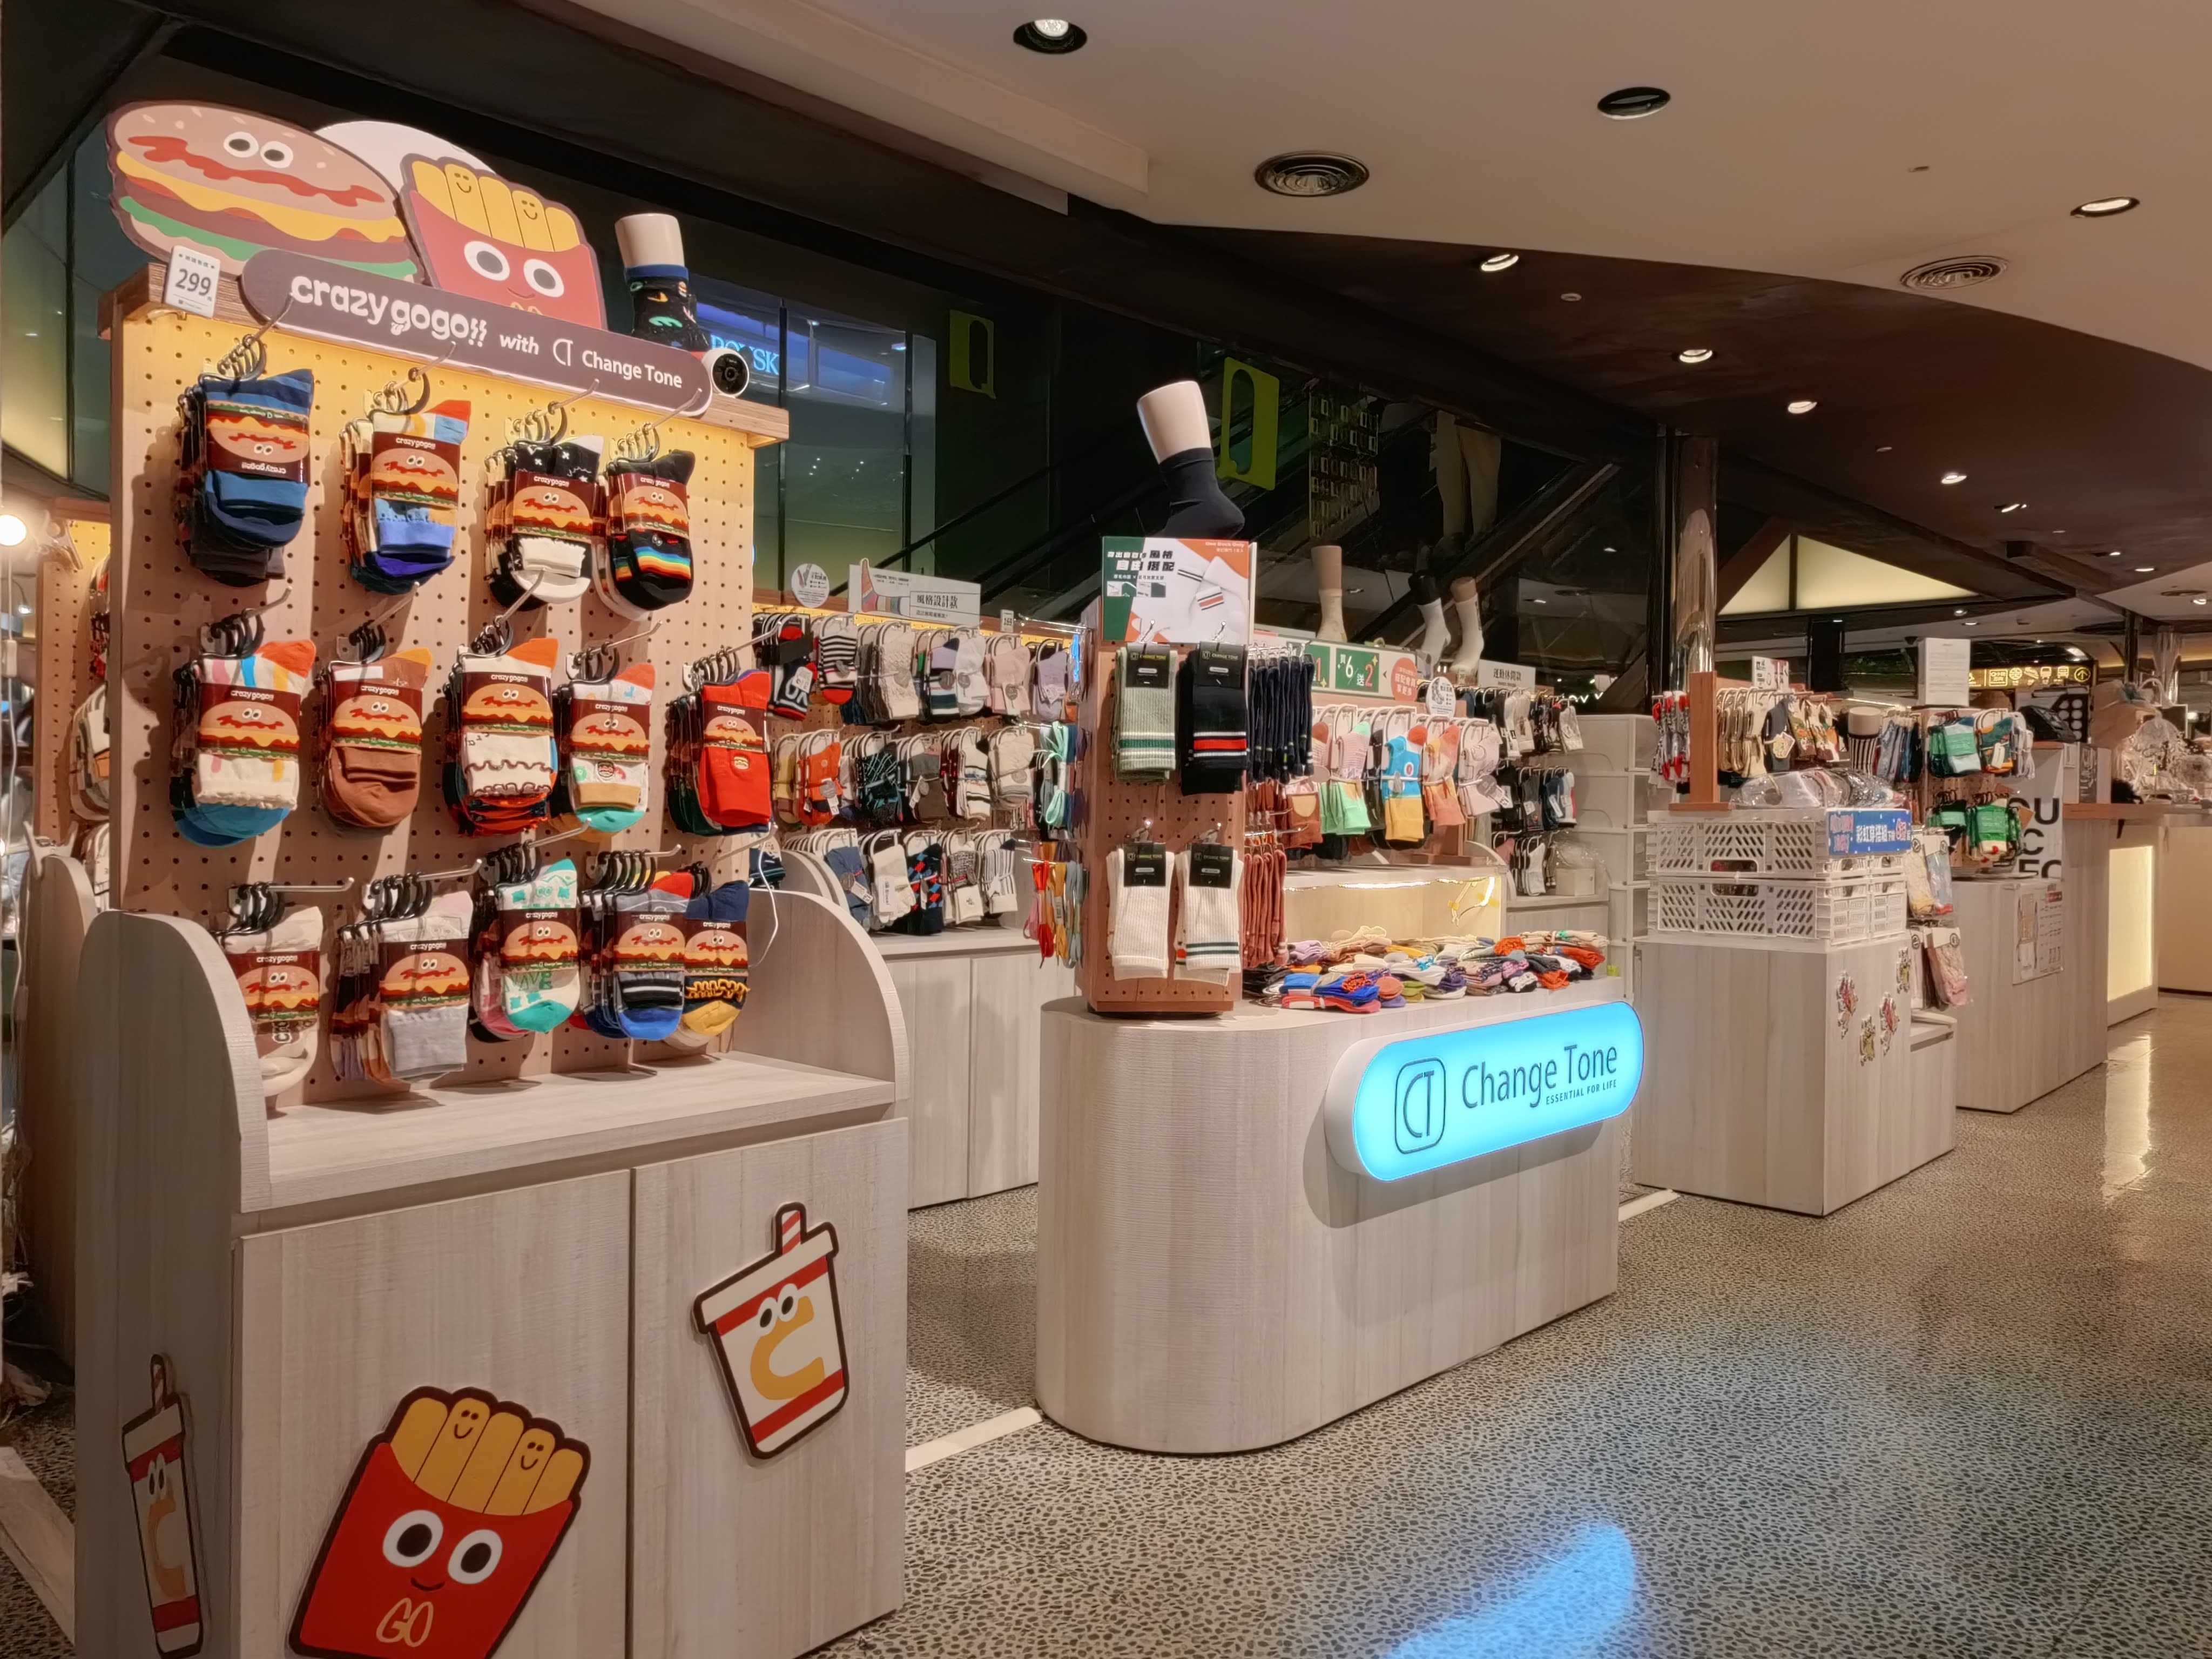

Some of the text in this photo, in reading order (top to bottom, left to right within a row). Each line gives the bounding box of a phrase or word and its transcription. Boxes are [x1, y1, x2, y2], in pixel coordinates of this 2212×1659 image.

[176, 268, 211, 296] 299
[500, 334, 539, 355] with
[582, 350, 642, 380] Change
[645, 364, 683, 389] Tone
[917, 595, 957, 609] 風格設計款
[1461, 1059, 1557, 1109] Change
[1564, 1044, 1617, 1084] Tone
[1546, 1080, 1617, 1105] ESSENTIAL FOR LIFE
[376, 1597, 434, 1647] GO
